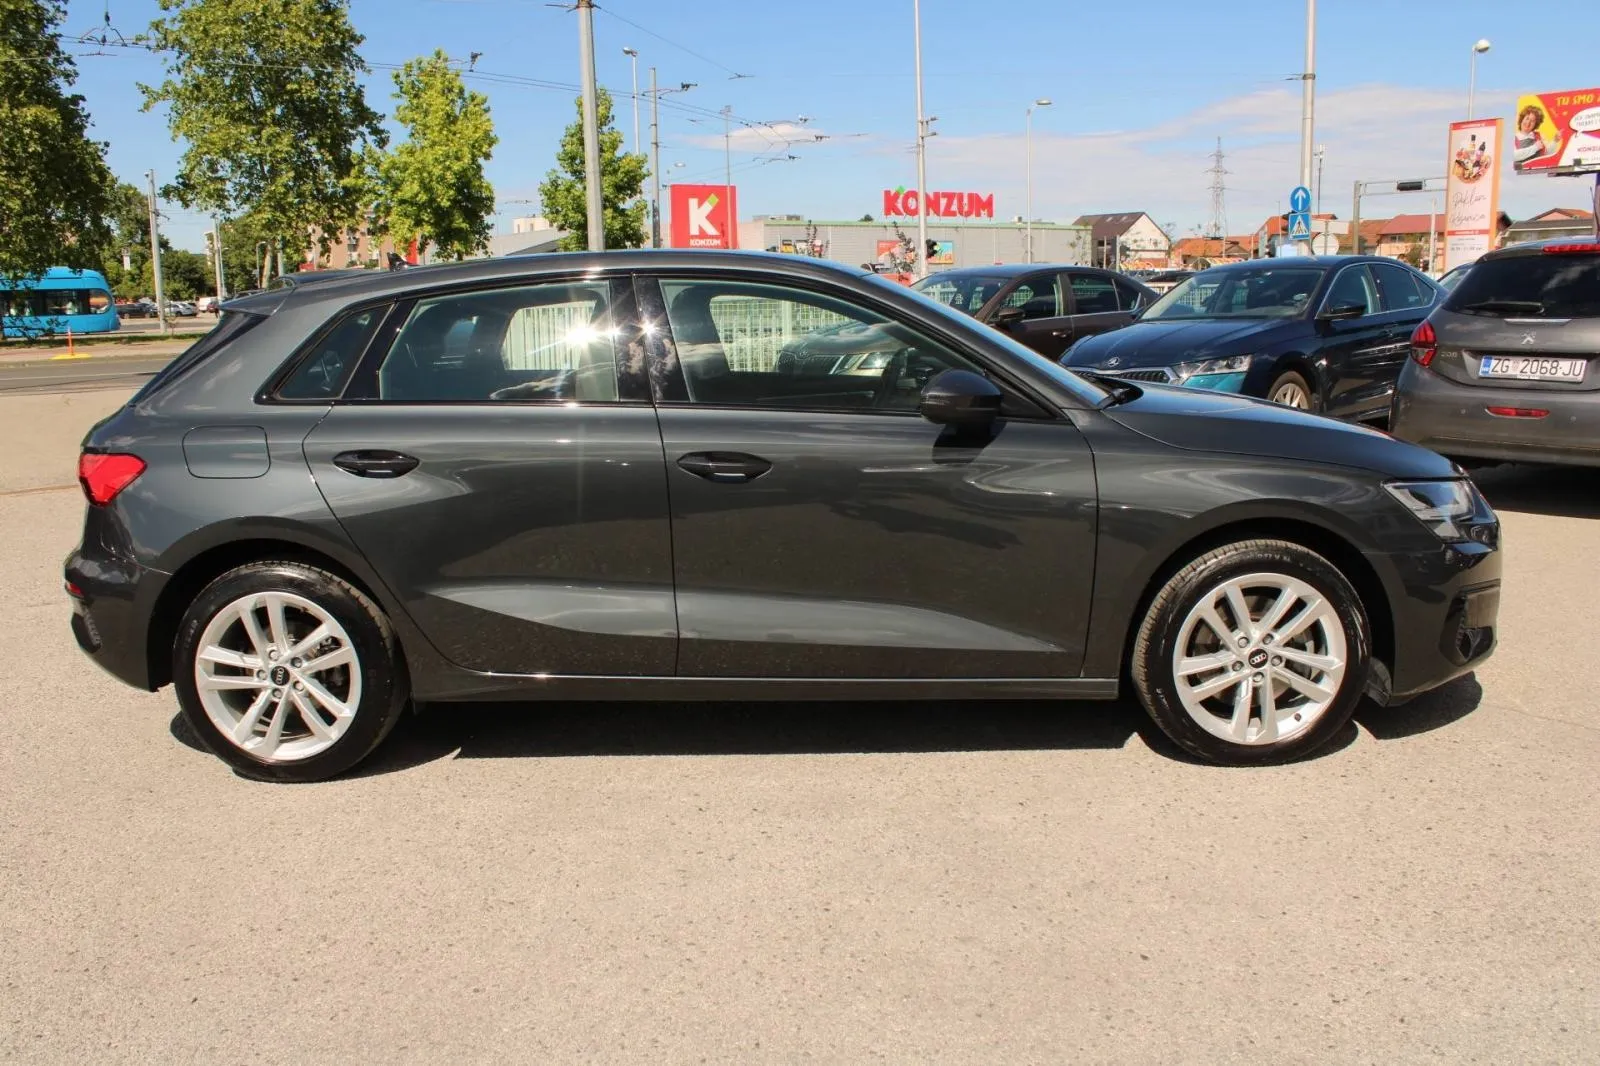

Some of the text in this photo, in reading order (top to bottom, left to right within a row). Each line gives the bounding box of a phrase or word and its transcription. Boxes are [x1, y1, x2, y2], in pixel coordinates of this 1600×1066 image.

[883, 186, 993, 218] KONZUM
[688, 193, 720, 236] K
[689, 238, 721, 246] KONZUM
[1491, 358, 1510, 373] ZG
